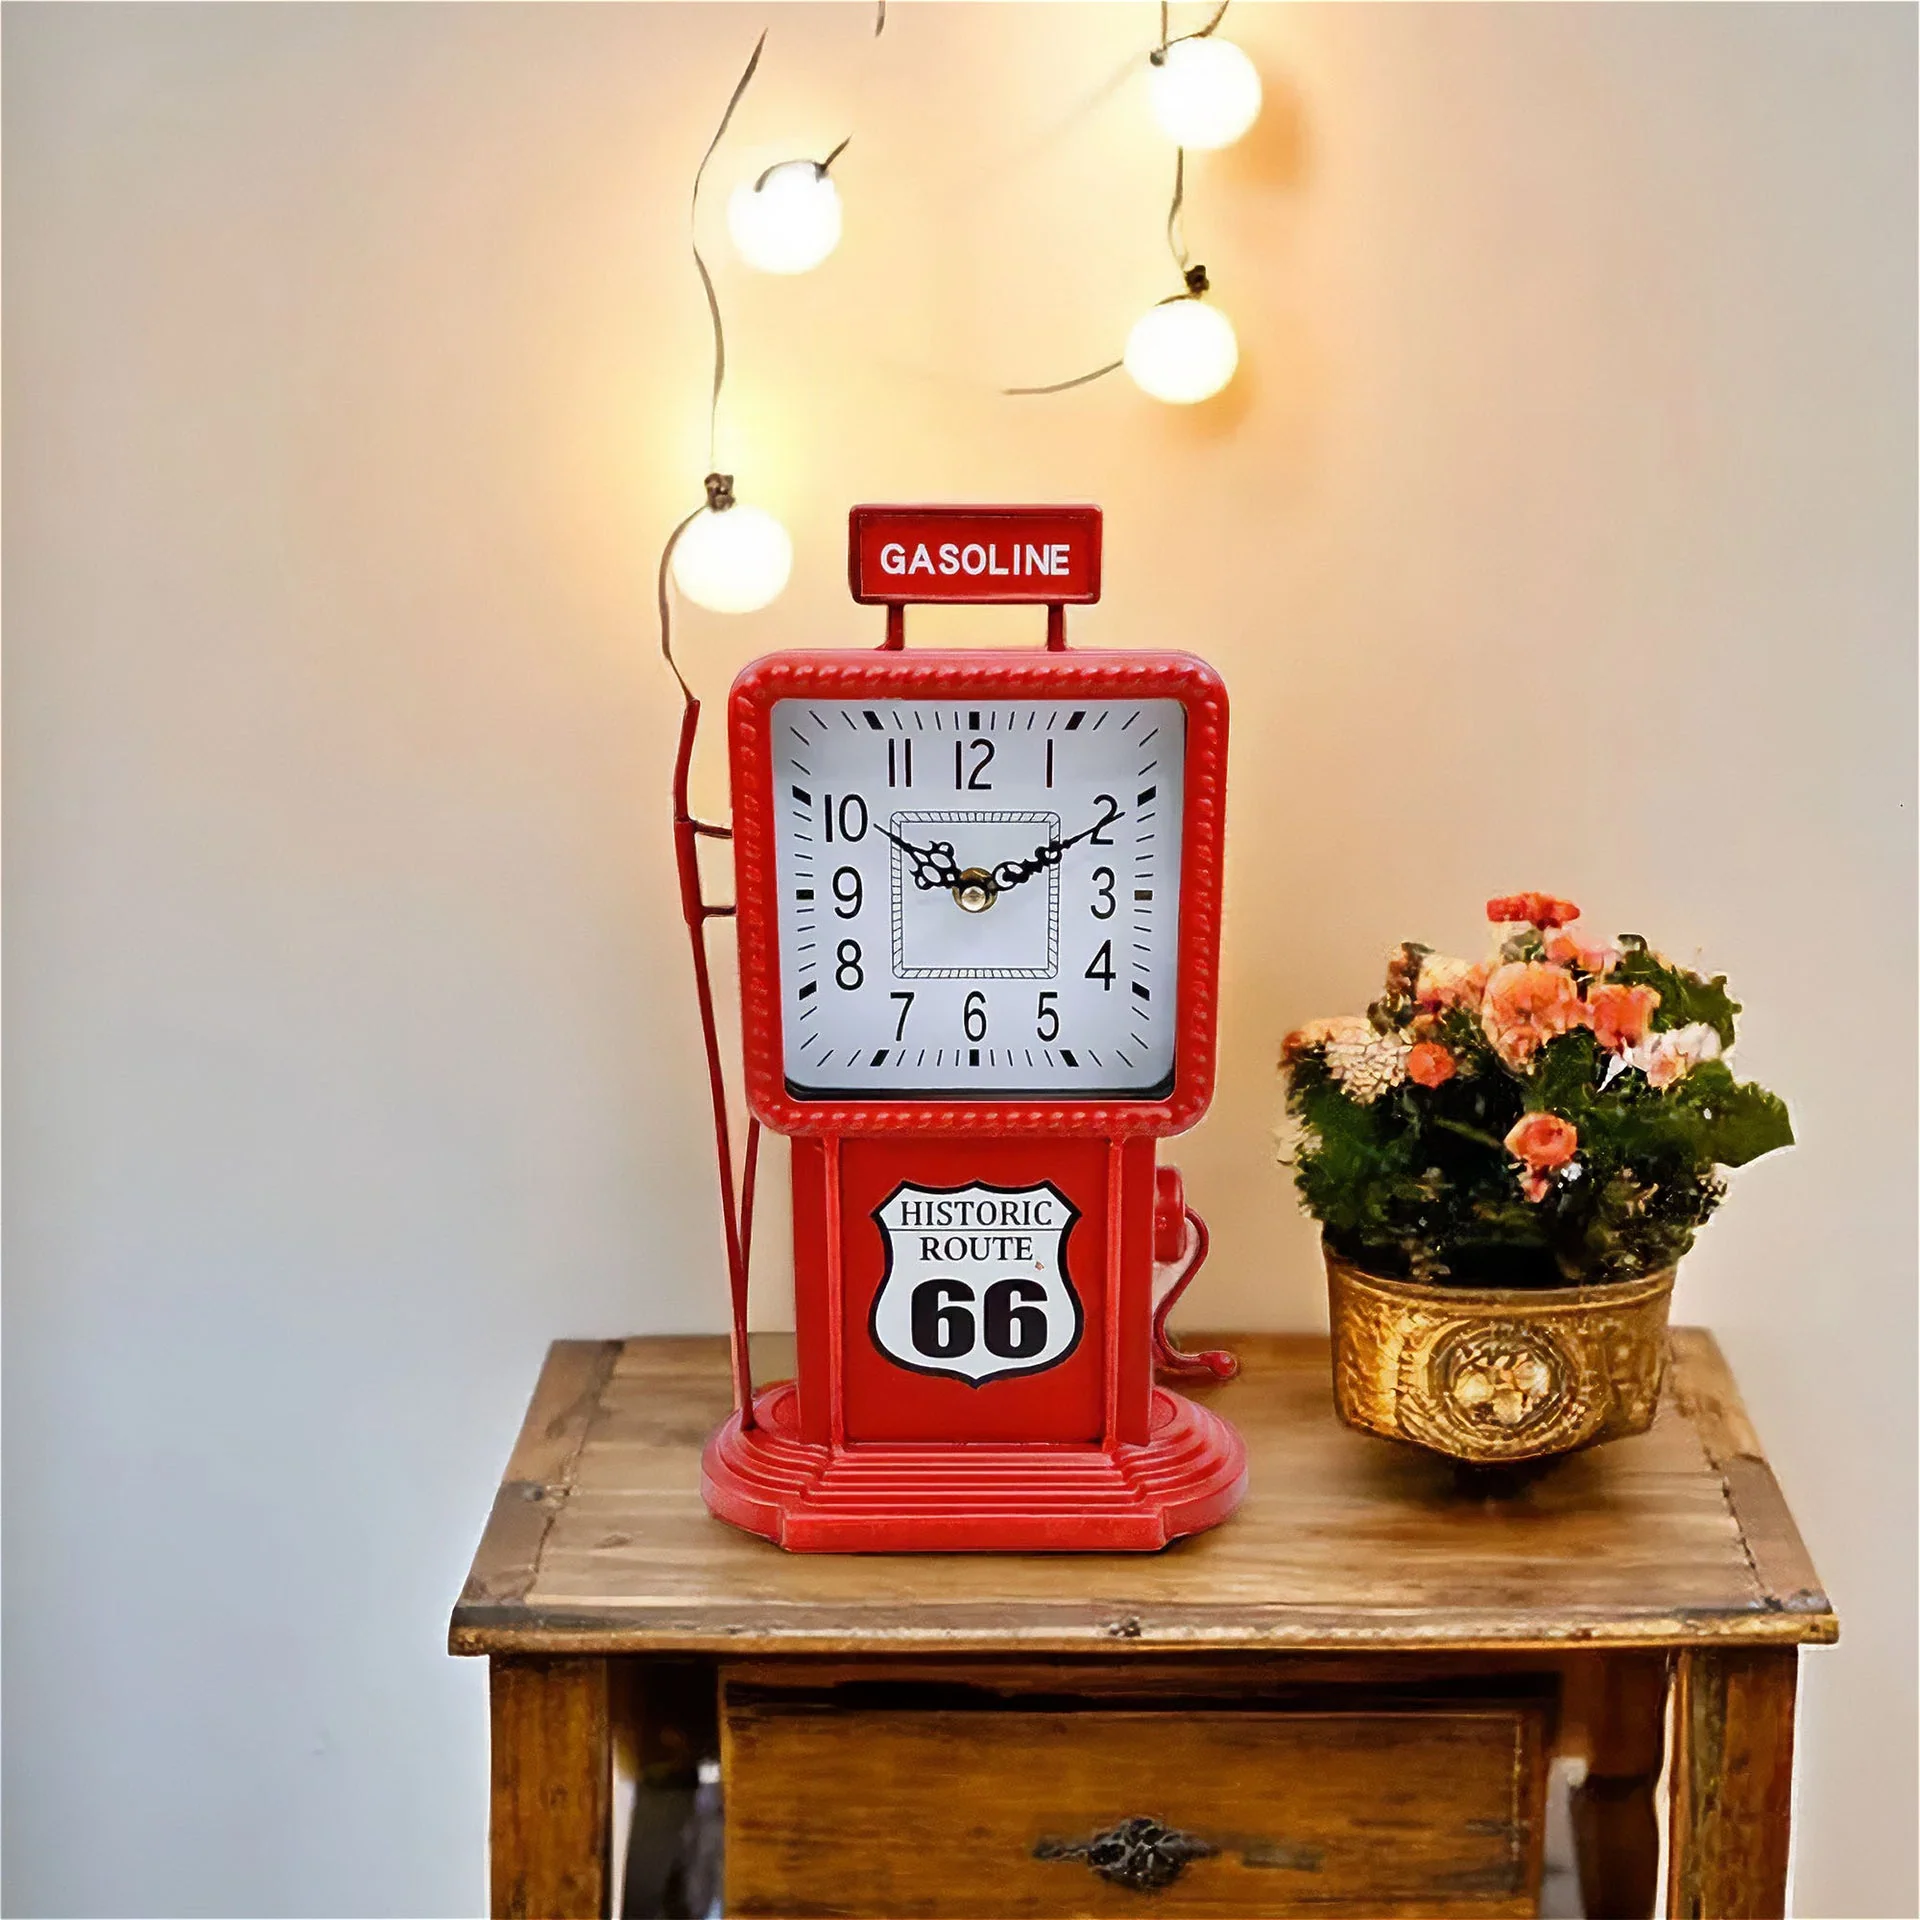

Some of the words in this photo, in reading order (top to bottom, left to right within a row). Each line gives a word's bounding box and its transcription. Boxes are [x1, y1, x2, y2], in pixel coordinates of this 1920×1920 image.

[881, 544, 1069, 575] GASOLINE
[889, 738, 911, 787] 11
[956, 739, 995, 790] 12
[1047, 739, 1053, 788] 1
[825, 794, 868, 842] 10
[1091, 795, 1118, 845] 2
[833, 866, 862, 919] 9
[1091, 867, 1115, 919] 3
[836, 939, 863, 990] 8
[1085, 940, 1116, 991] 4
[891, 992, 914, 1041] 7
[964, 991, 986, 1042] 6
[1037, 992, 1059, 1042] 5
[901, 1201, 1051, 1225] HISTORIC
[920, 1237, 1032, 1260] ROUTE
[911, 1279, 1047, 1358] 66
